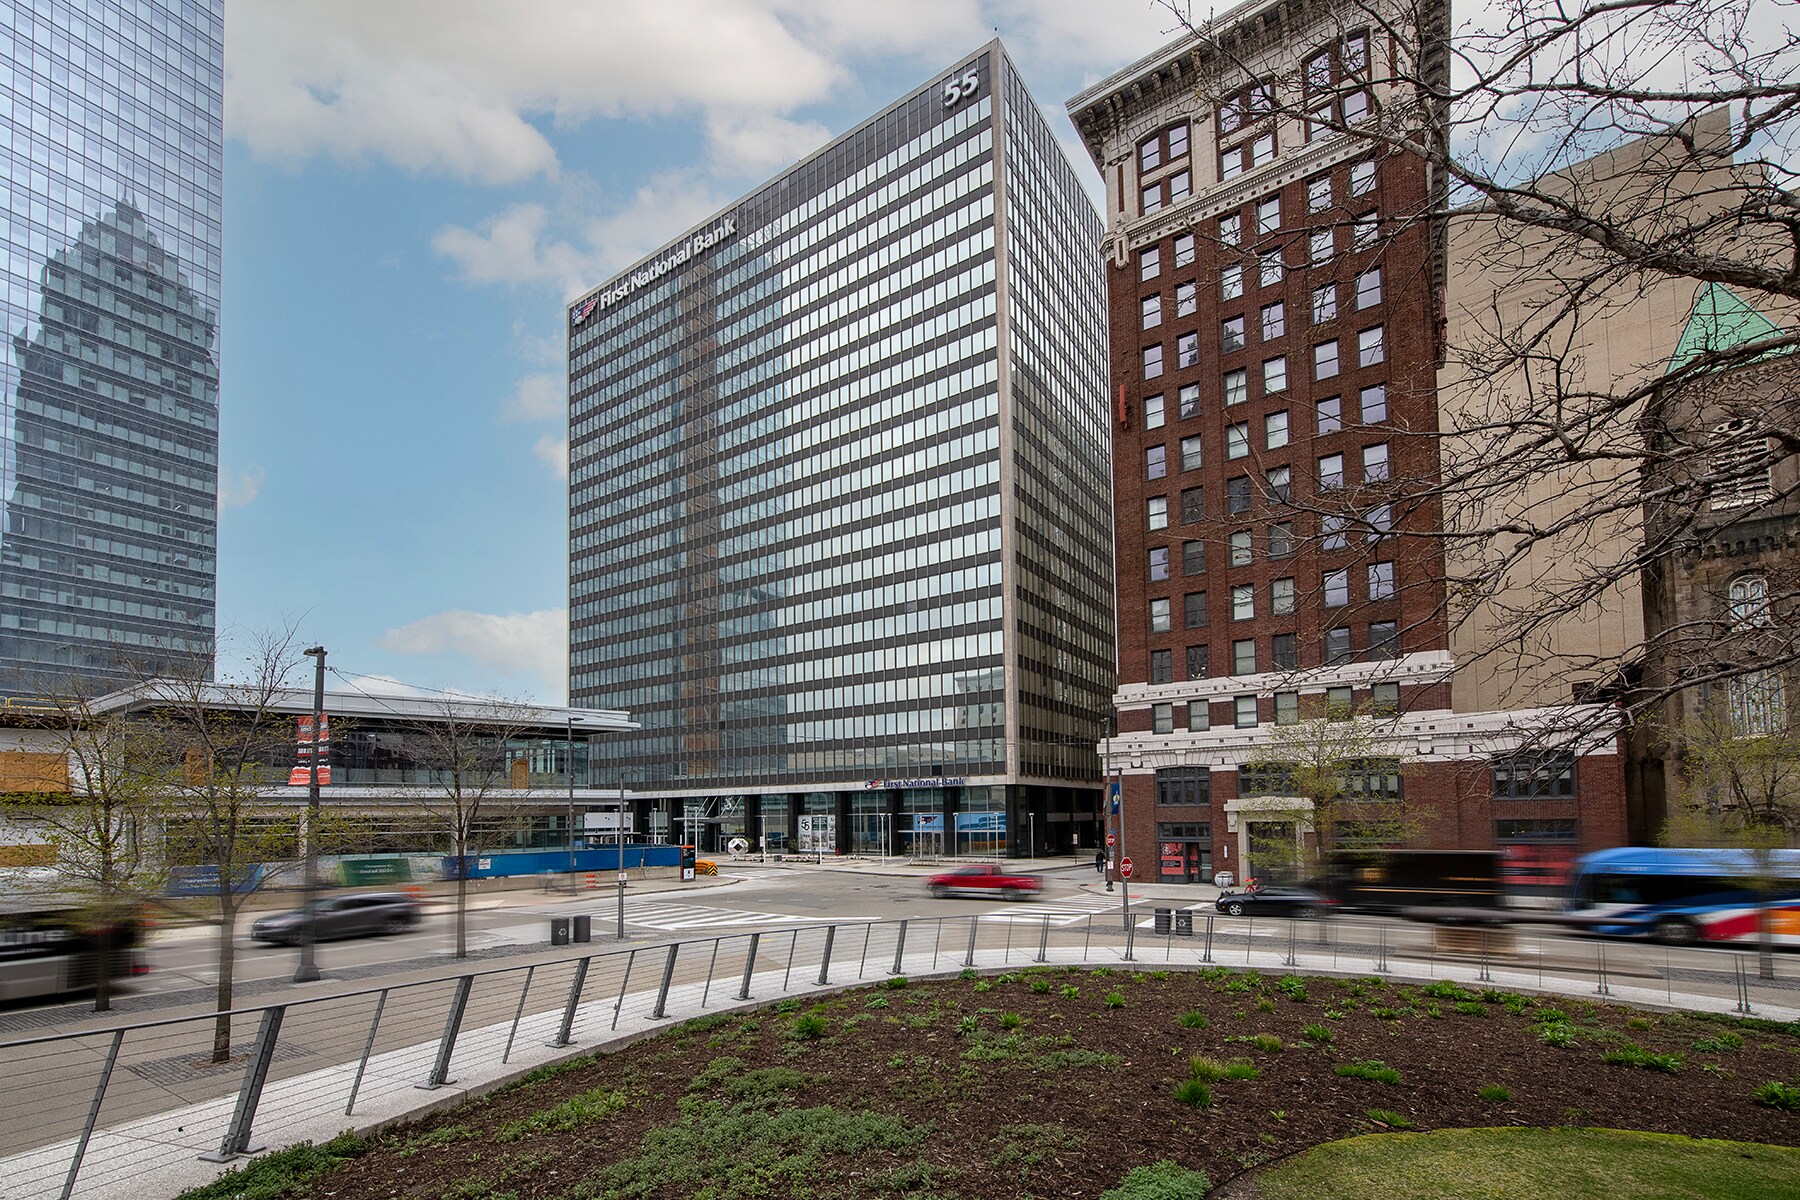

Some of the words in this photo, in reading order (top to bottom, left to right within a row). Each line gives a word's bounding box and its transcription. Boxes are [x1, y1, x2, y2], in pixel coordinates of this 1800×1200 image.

[944, 67, 979, 107] 55
[600, 281, 631, 311] First
[631, 243, 691, 293] National
[693, 217, 737, 255] Bank
[884, 779, 901, 788] First
[903, 778, 939, 788] National
[941, 777, 965, 786] Bank
[1121, 863, 1132, 872] STOP
